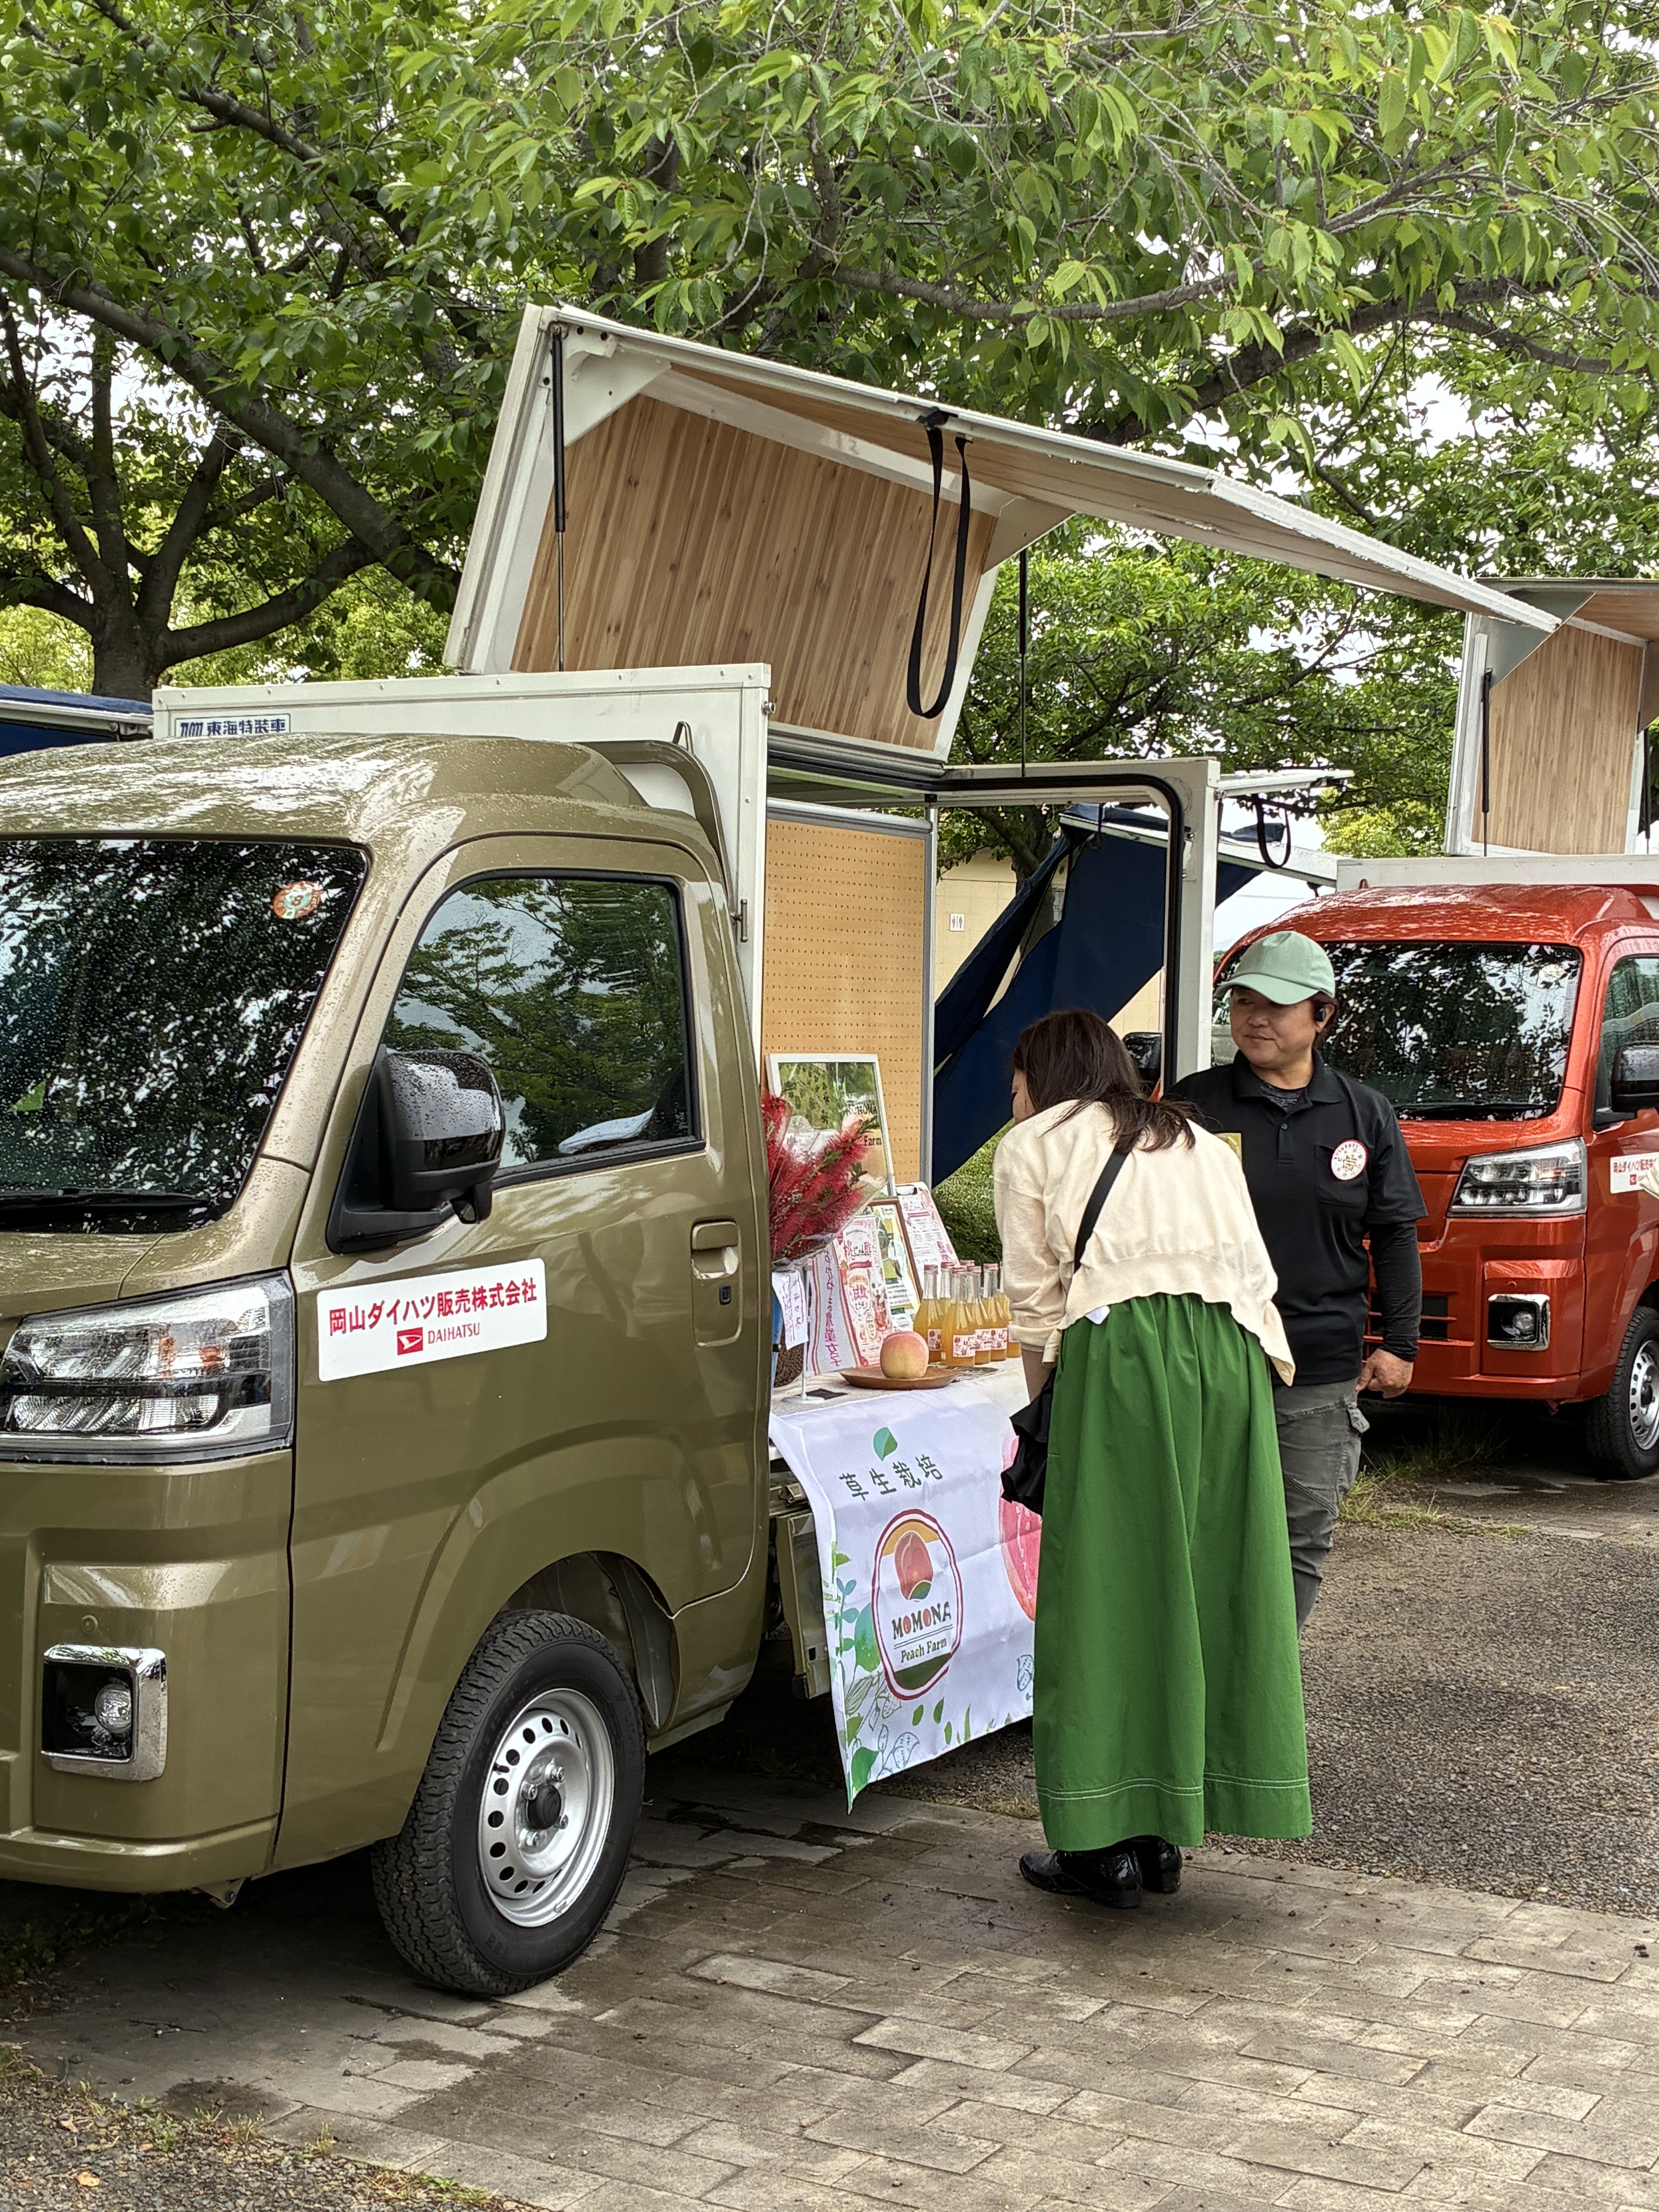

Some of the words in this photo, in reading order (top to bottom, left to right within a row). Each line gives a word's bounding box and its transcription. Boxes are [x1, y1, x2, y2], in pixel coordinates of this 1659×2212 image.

[207, 718, 286, 736] 東海特装車
[329, 1277, 538, 1336] 岡山ダイハツ販売株式会社
[428, 1322, 480, 1344] DAIHATSU
[839, 1454, 943, 1501] 草生栽培
[892, 1601, 951, 1640] MOMONA
[901, 1644, 925, 1663] Peach
[927, 1637, 947, 1654] Farm
